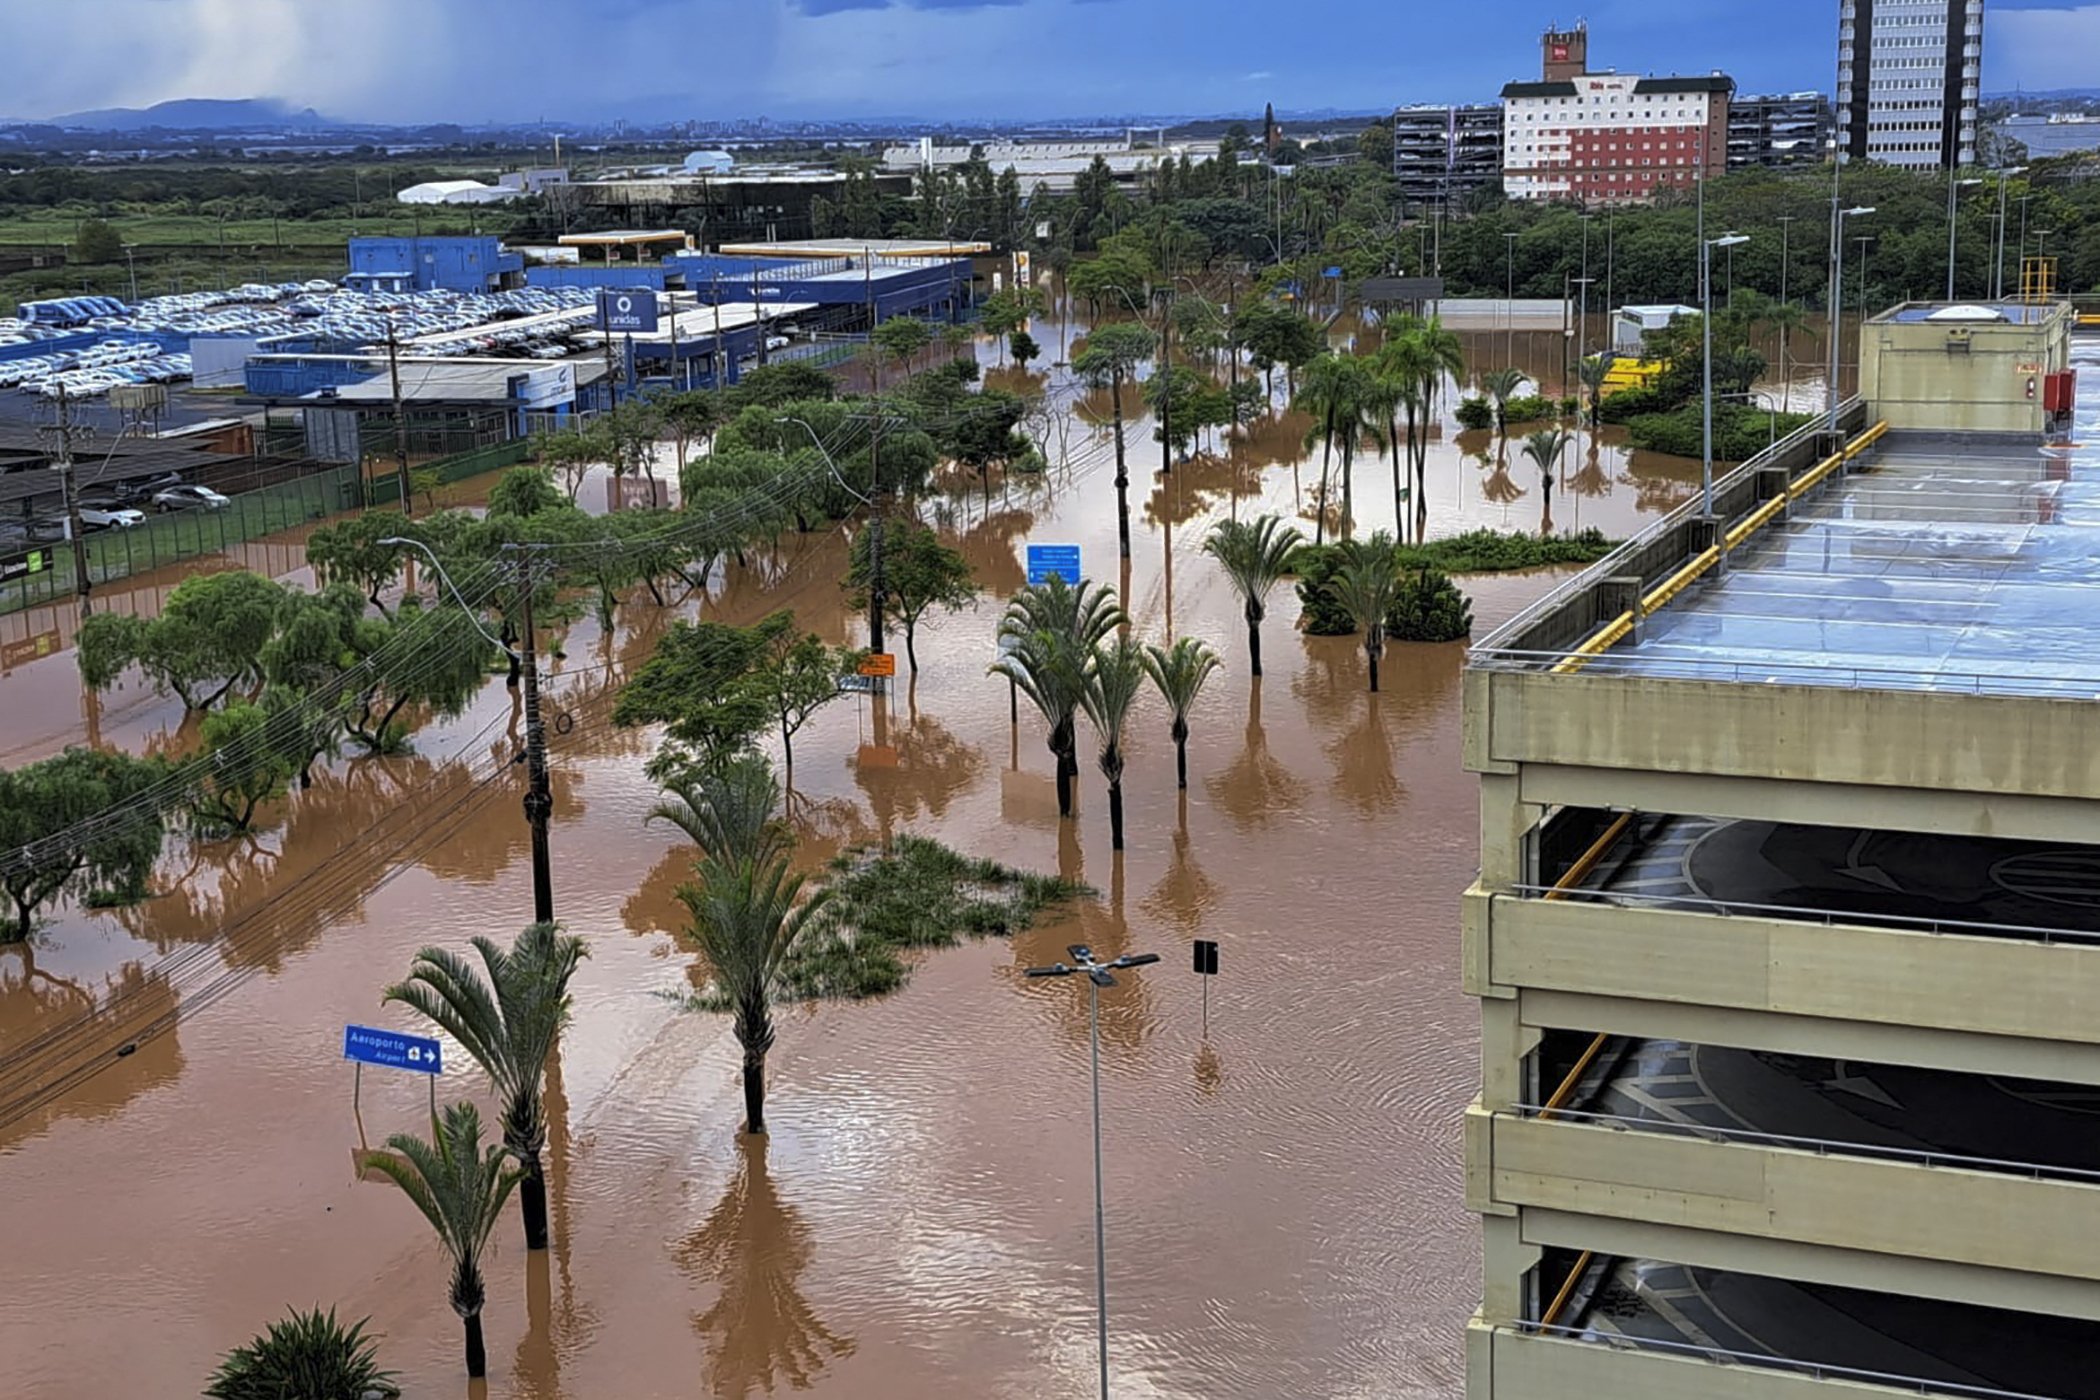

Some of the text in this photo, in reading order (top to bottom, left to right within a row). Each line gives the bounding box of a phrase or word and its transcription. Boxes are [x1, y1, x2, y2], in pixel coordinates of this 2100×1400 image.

[609, 314, 641, 325] unidas
[350, 1031, 406, 1051] Aeroporto
[374, 1050, 406, 1063] Airport
